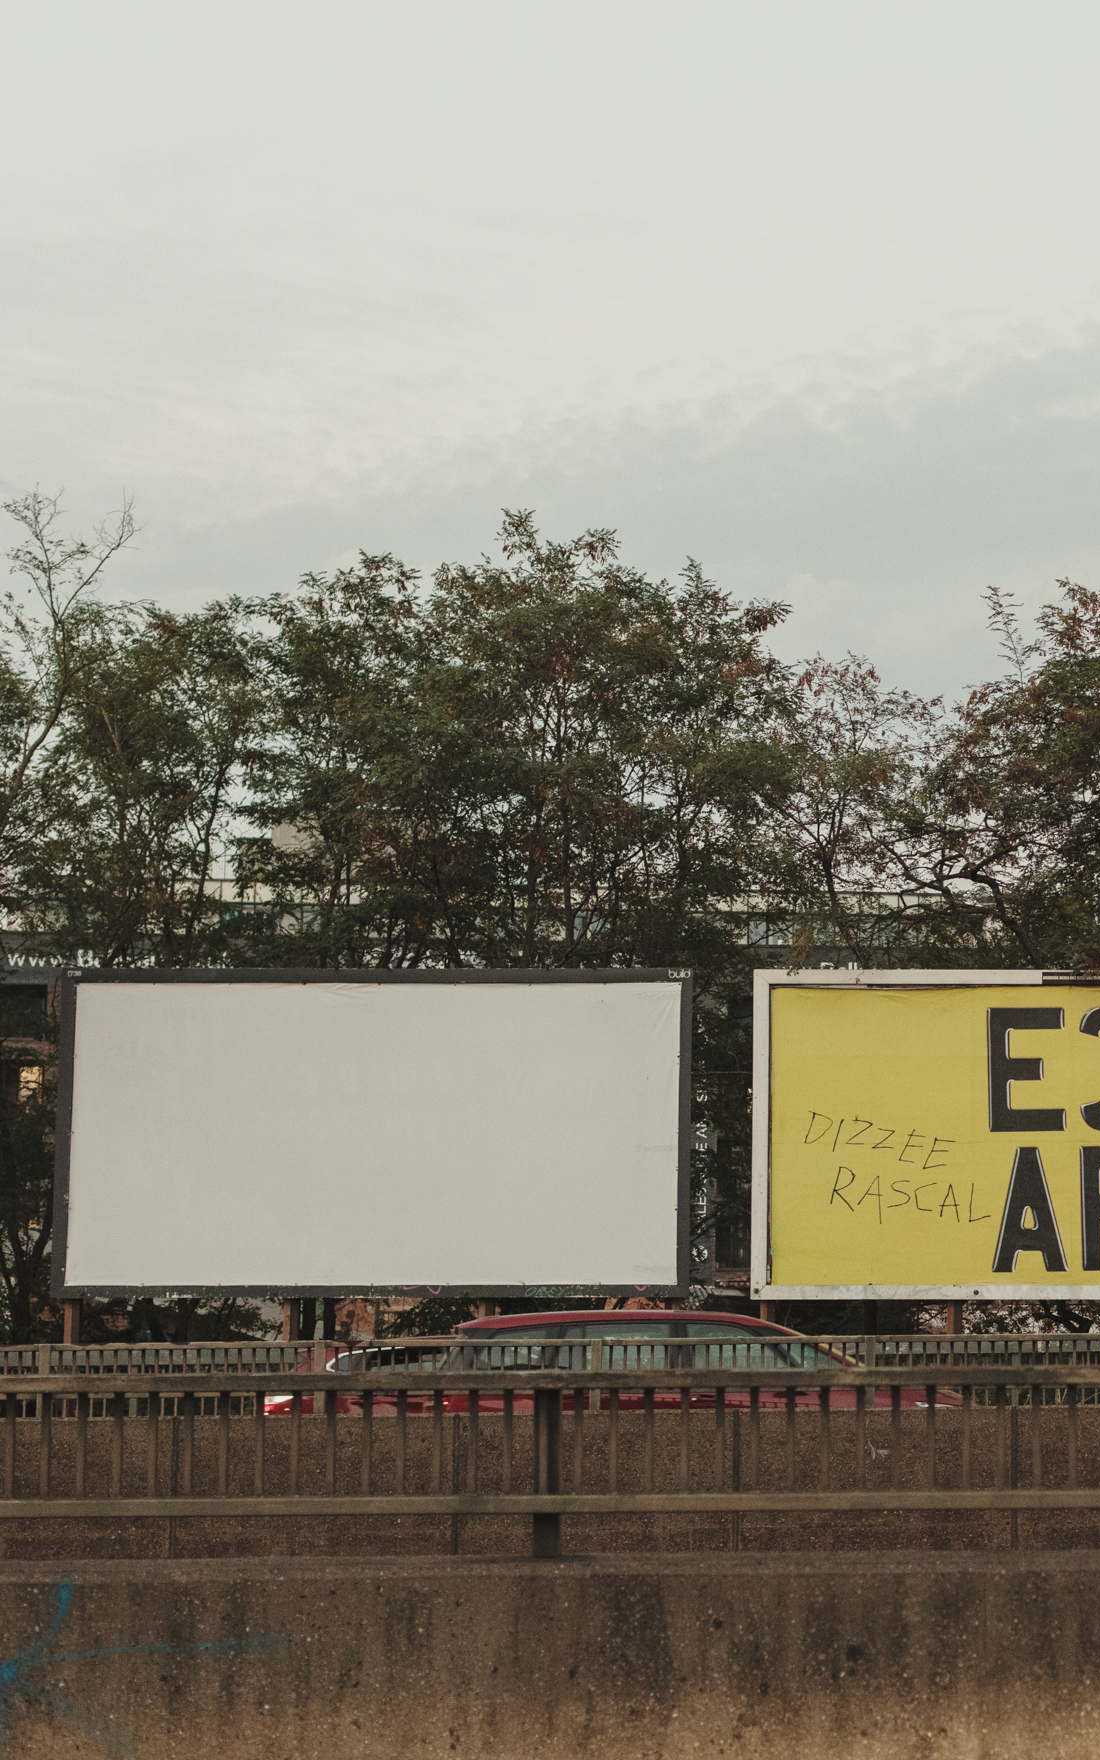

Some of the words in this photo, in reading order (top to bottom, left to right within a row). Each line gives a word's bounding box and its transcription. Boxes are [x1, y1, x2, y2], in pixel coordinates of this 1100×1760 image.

[668, 969, 691, 979] build
[803, 1110, 956, 1170] DIZZEE
[830, 1166, 992, 1225] RASCAL
